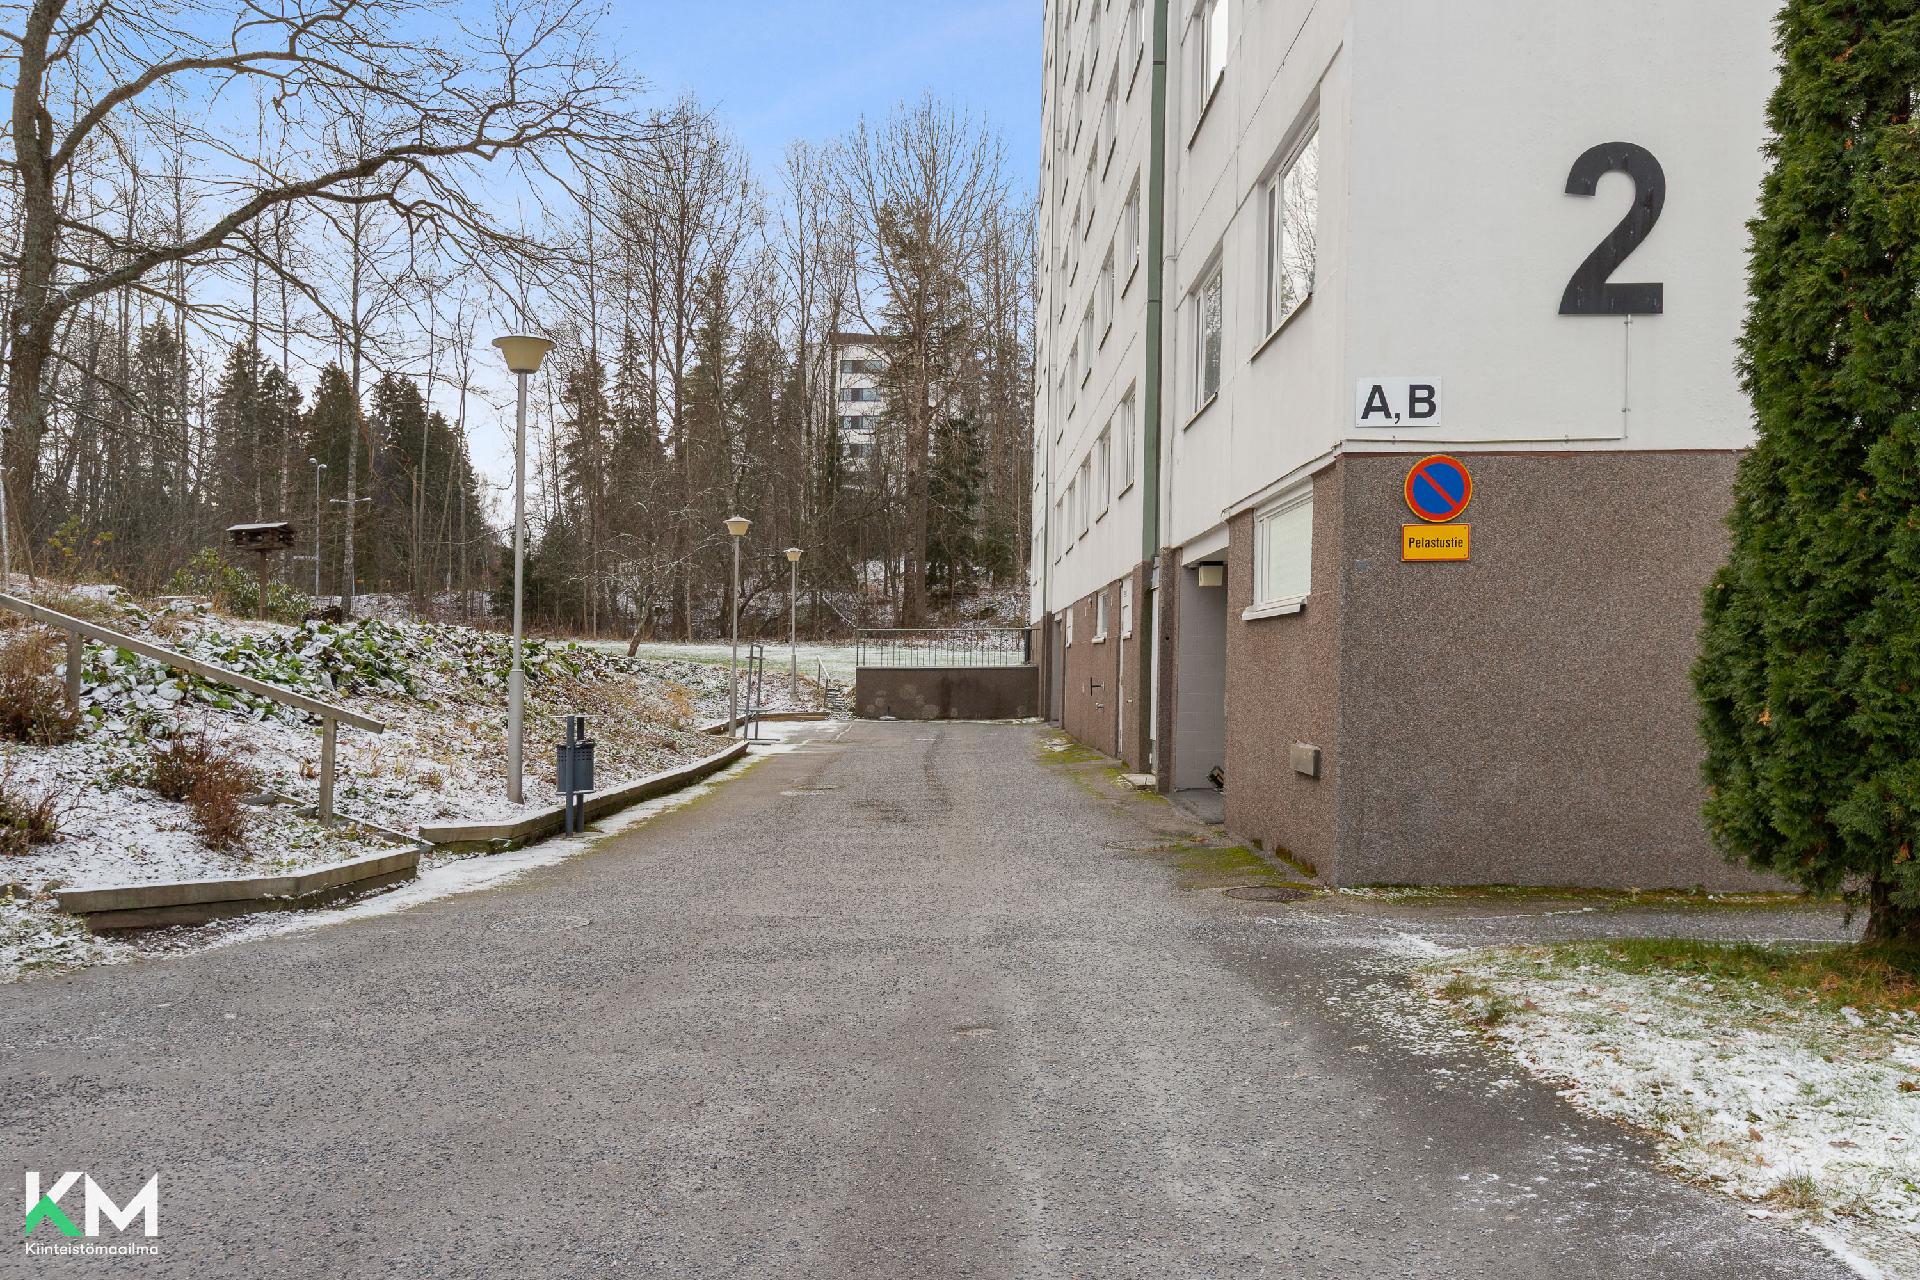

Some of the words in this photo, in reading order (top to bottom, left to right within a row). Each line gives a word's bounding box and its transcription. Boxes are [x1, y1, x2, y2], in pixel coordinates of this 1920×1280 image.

[1559, 142, 1665, 316] 2
[1360, 384, 1437, 424] A,B
[1408, 537, 1463, 548] Pelastustie
